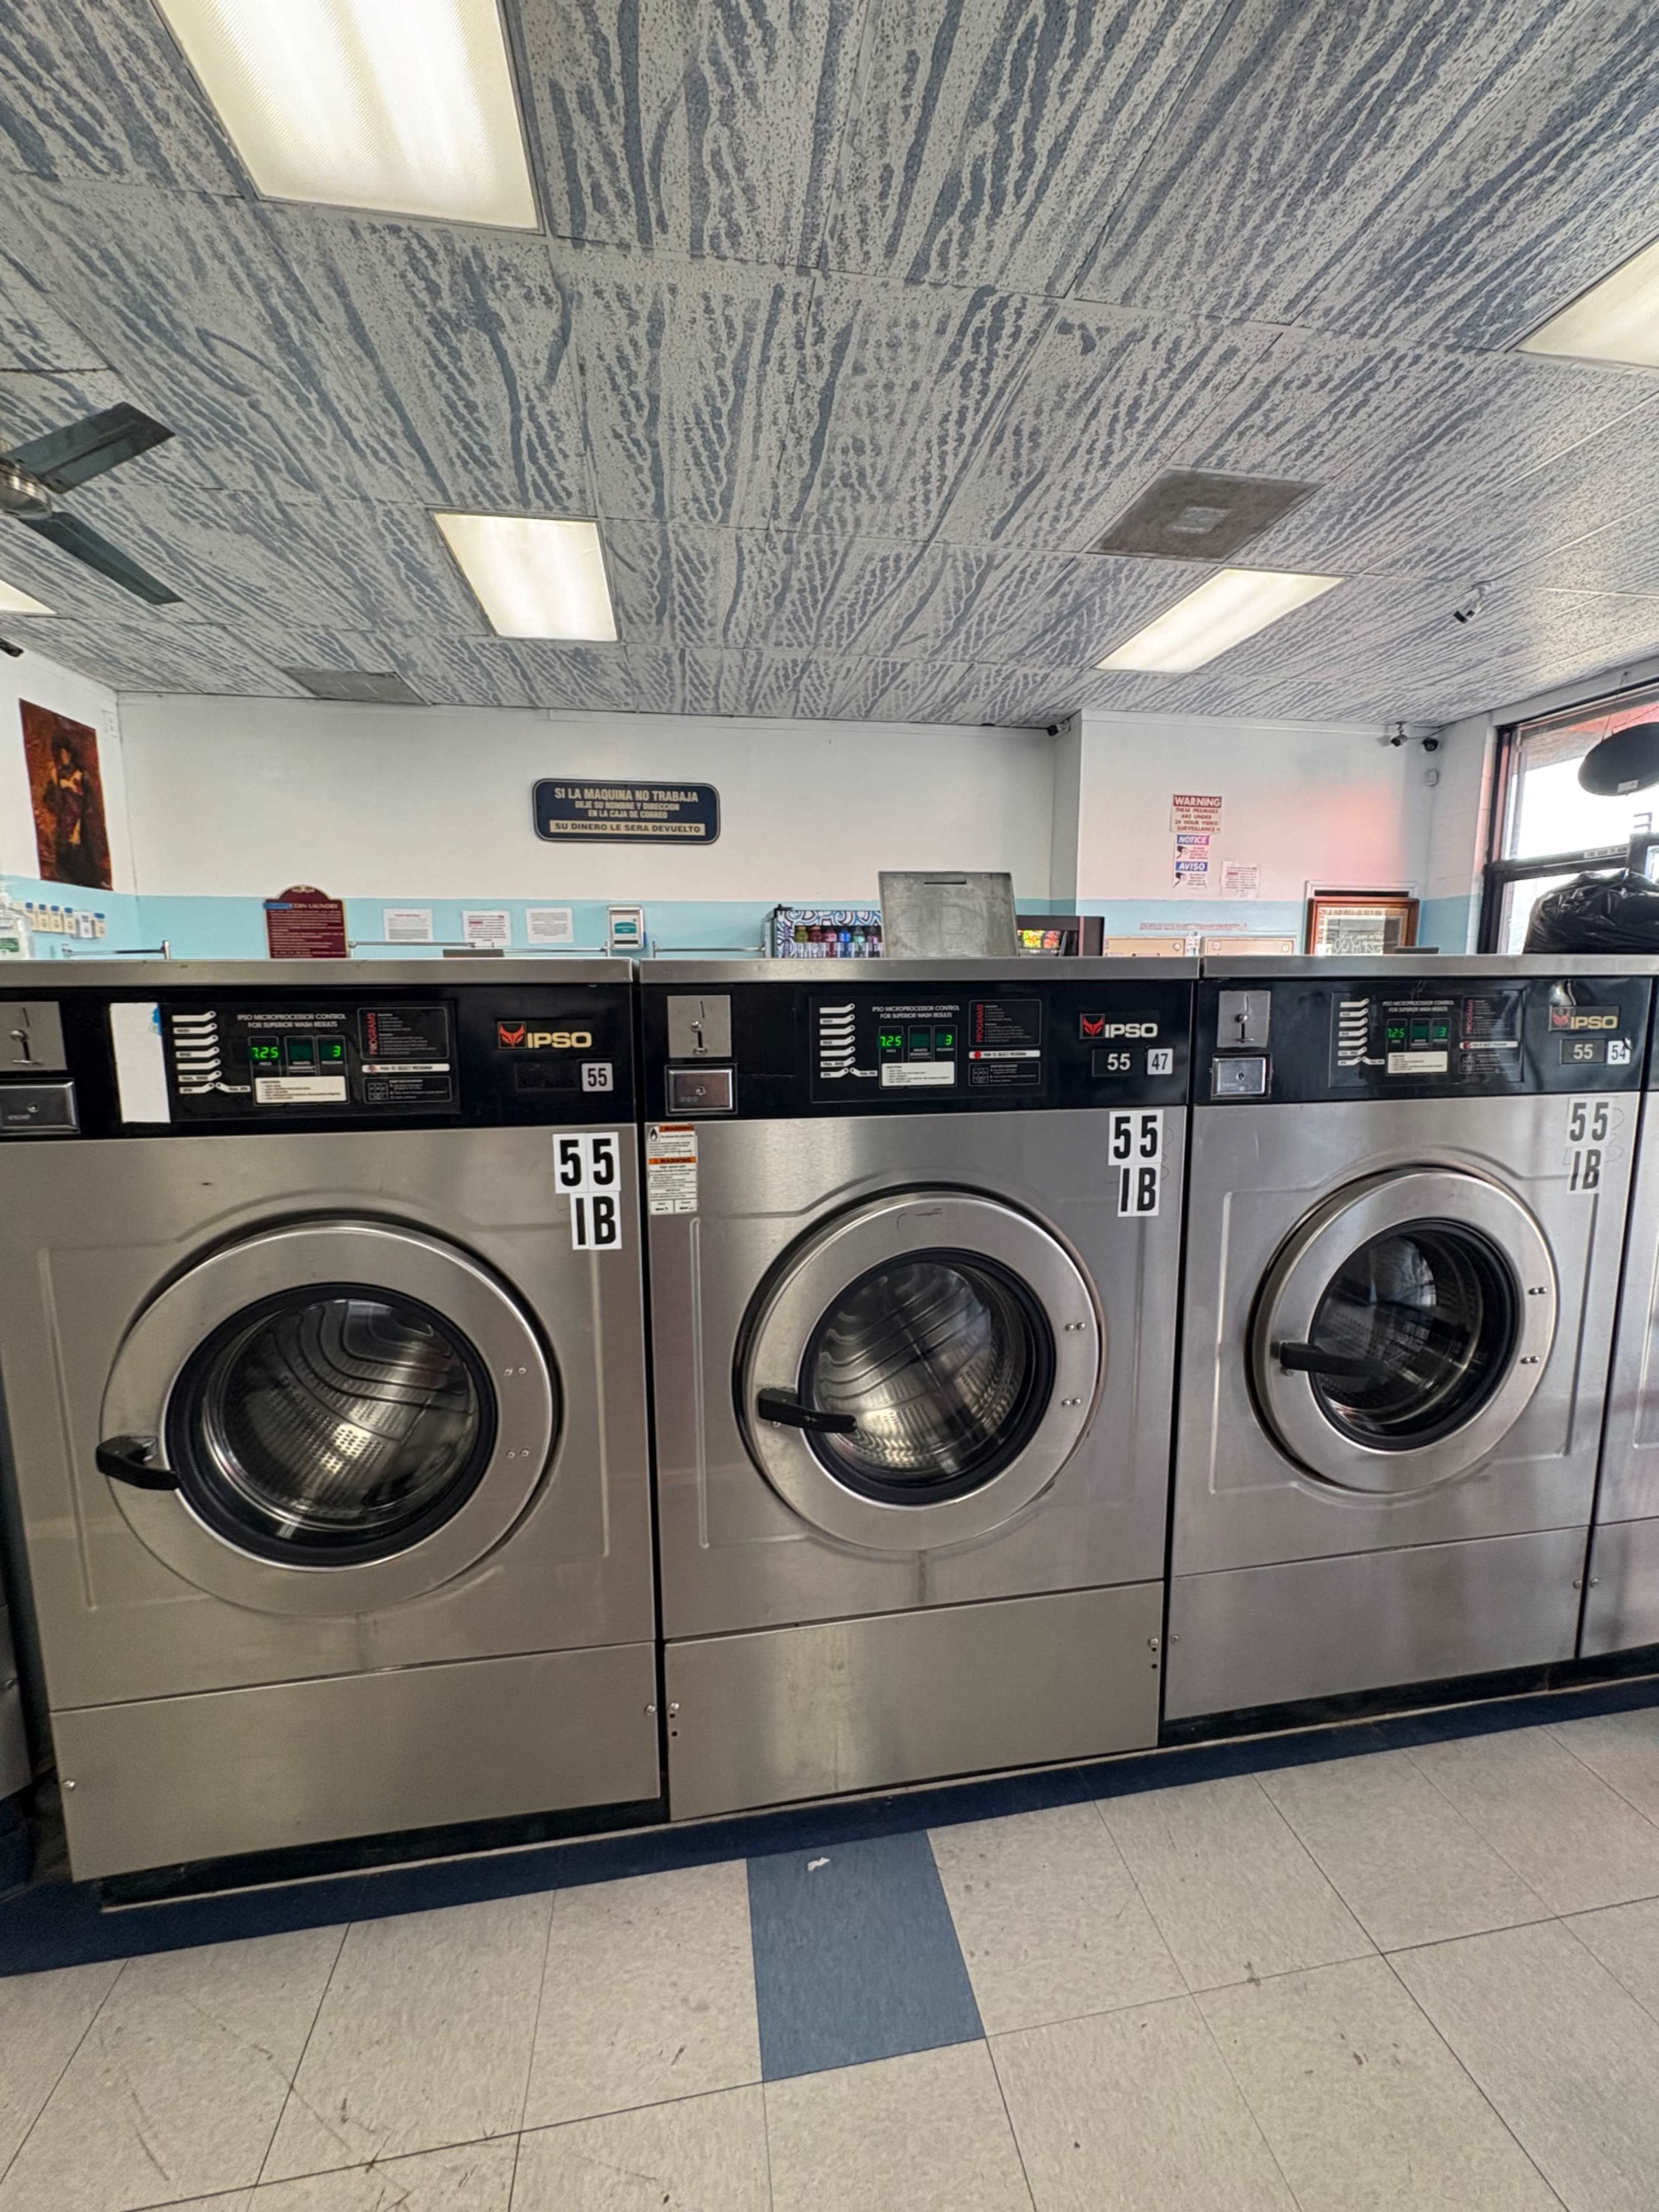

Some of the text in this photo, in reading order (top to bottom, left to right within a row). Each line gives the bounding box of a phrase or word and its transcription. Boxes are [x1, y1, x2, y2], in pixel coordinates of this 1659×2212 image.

[554, 788, 699, 802] SI LA MAQUINA NO TRABAJA
[1174, 797, 1221, 807] WARNING
[1570, 1016, 1618, 1029] IPSO
[367, 1013, 378, 1055] PROGRAMS
[1105, 1023, 1158, 1038] IPSO
[1440, 1027, 1446, 1037] 3
[527, 1032, 592, 1049] IPSO
[945, 1035, 953, 1046] 3
[332, 1046, 341, 1057] 3
[1573, 1044, 1593, 1059] 55
[1611, 1045, 1626, 1060] 54
[1107, 1053, 1131, 1071] 55
[1152, 1053, 1168, 1070] 47
[588, 1068, 607, 1087] 55
[1570, 1102, 1609, 1141] 55
[1113, 1115, 1157, 1159] 55
[560, 1138, 614, 1187] 55
